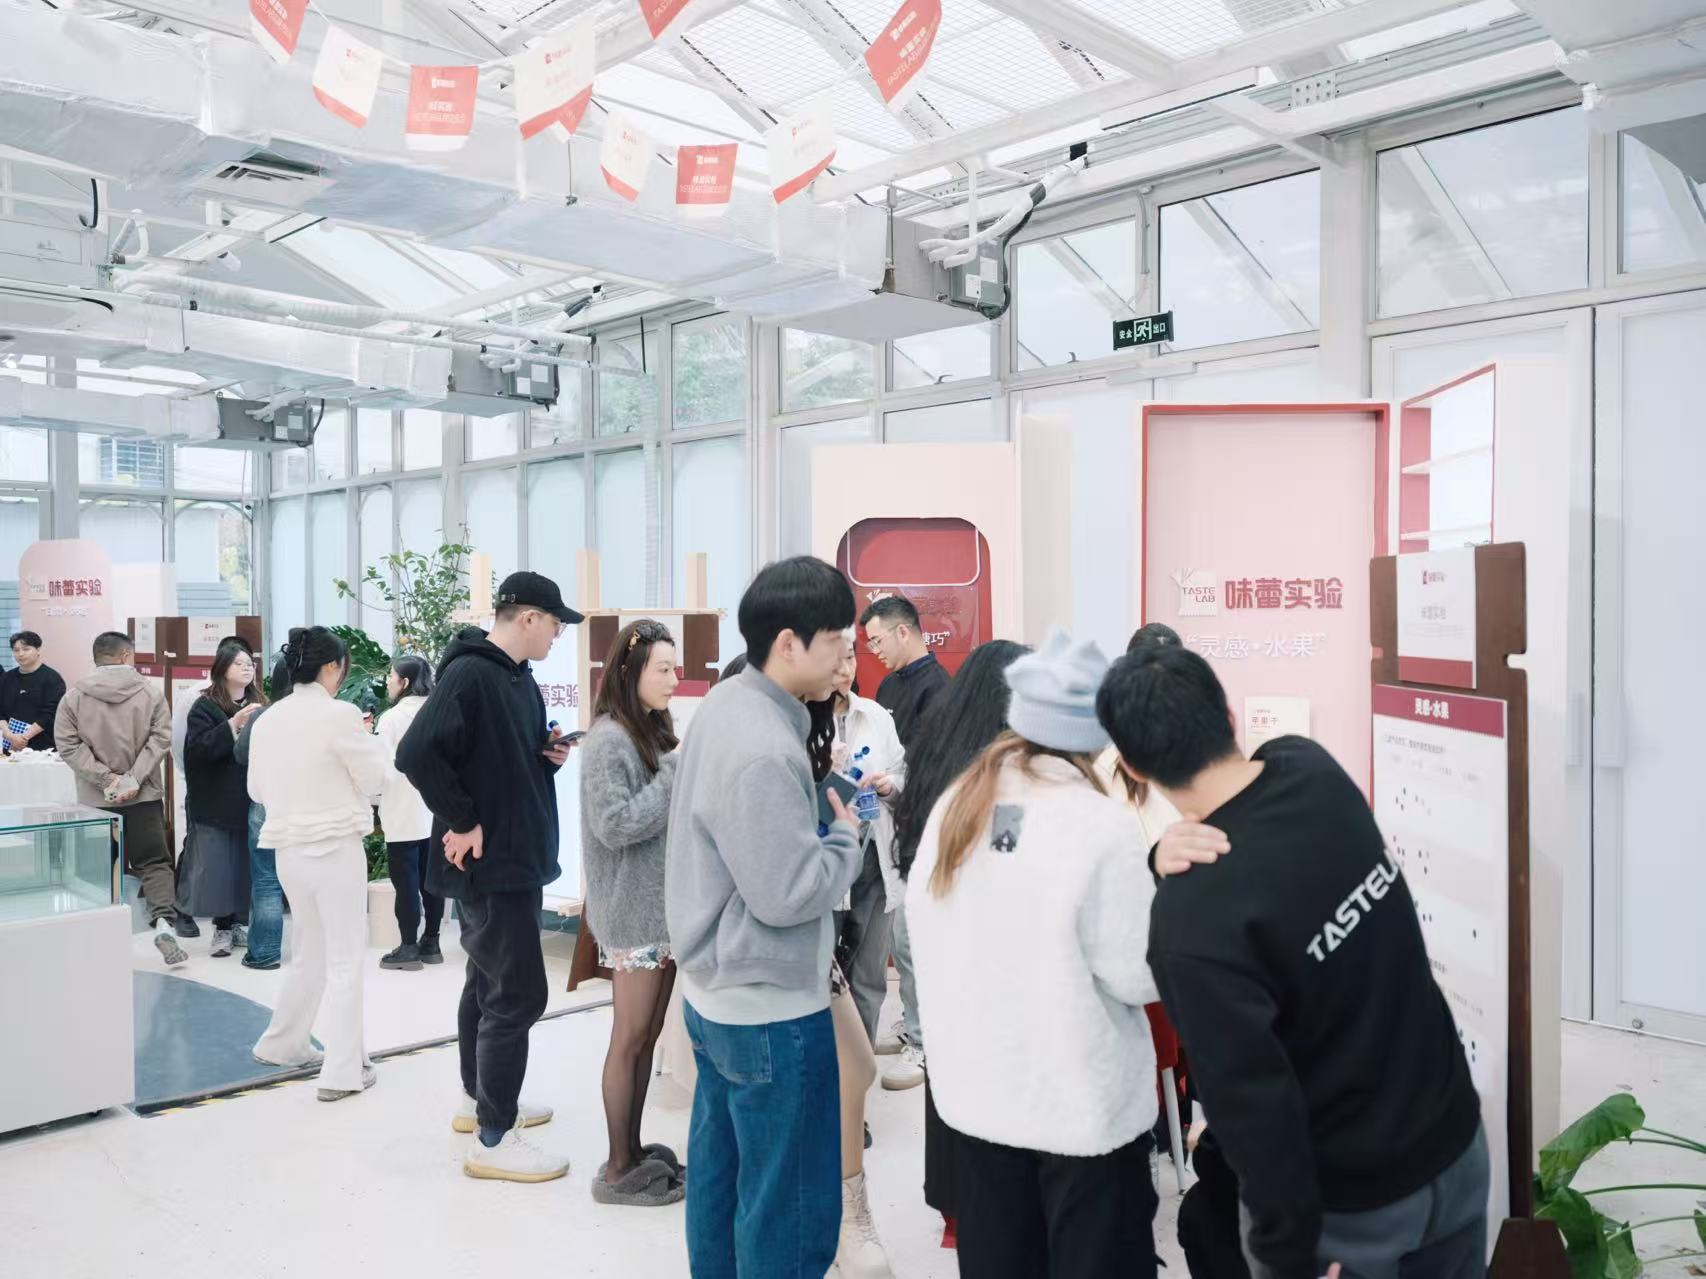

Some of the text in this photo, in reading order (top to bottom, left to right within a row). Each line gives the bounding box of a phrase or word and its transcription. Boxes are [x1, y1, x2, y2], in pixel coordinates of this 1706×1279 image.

[1119, 322, 1166, 340] 安全 出口
[48, 578, 103, 598] 味蕾实验
[1182, 586, 1216, 595] TASTE
[1224, 576, 1344, 610] 味蕾实验
[1195, 595, 1216, 603] LAB
